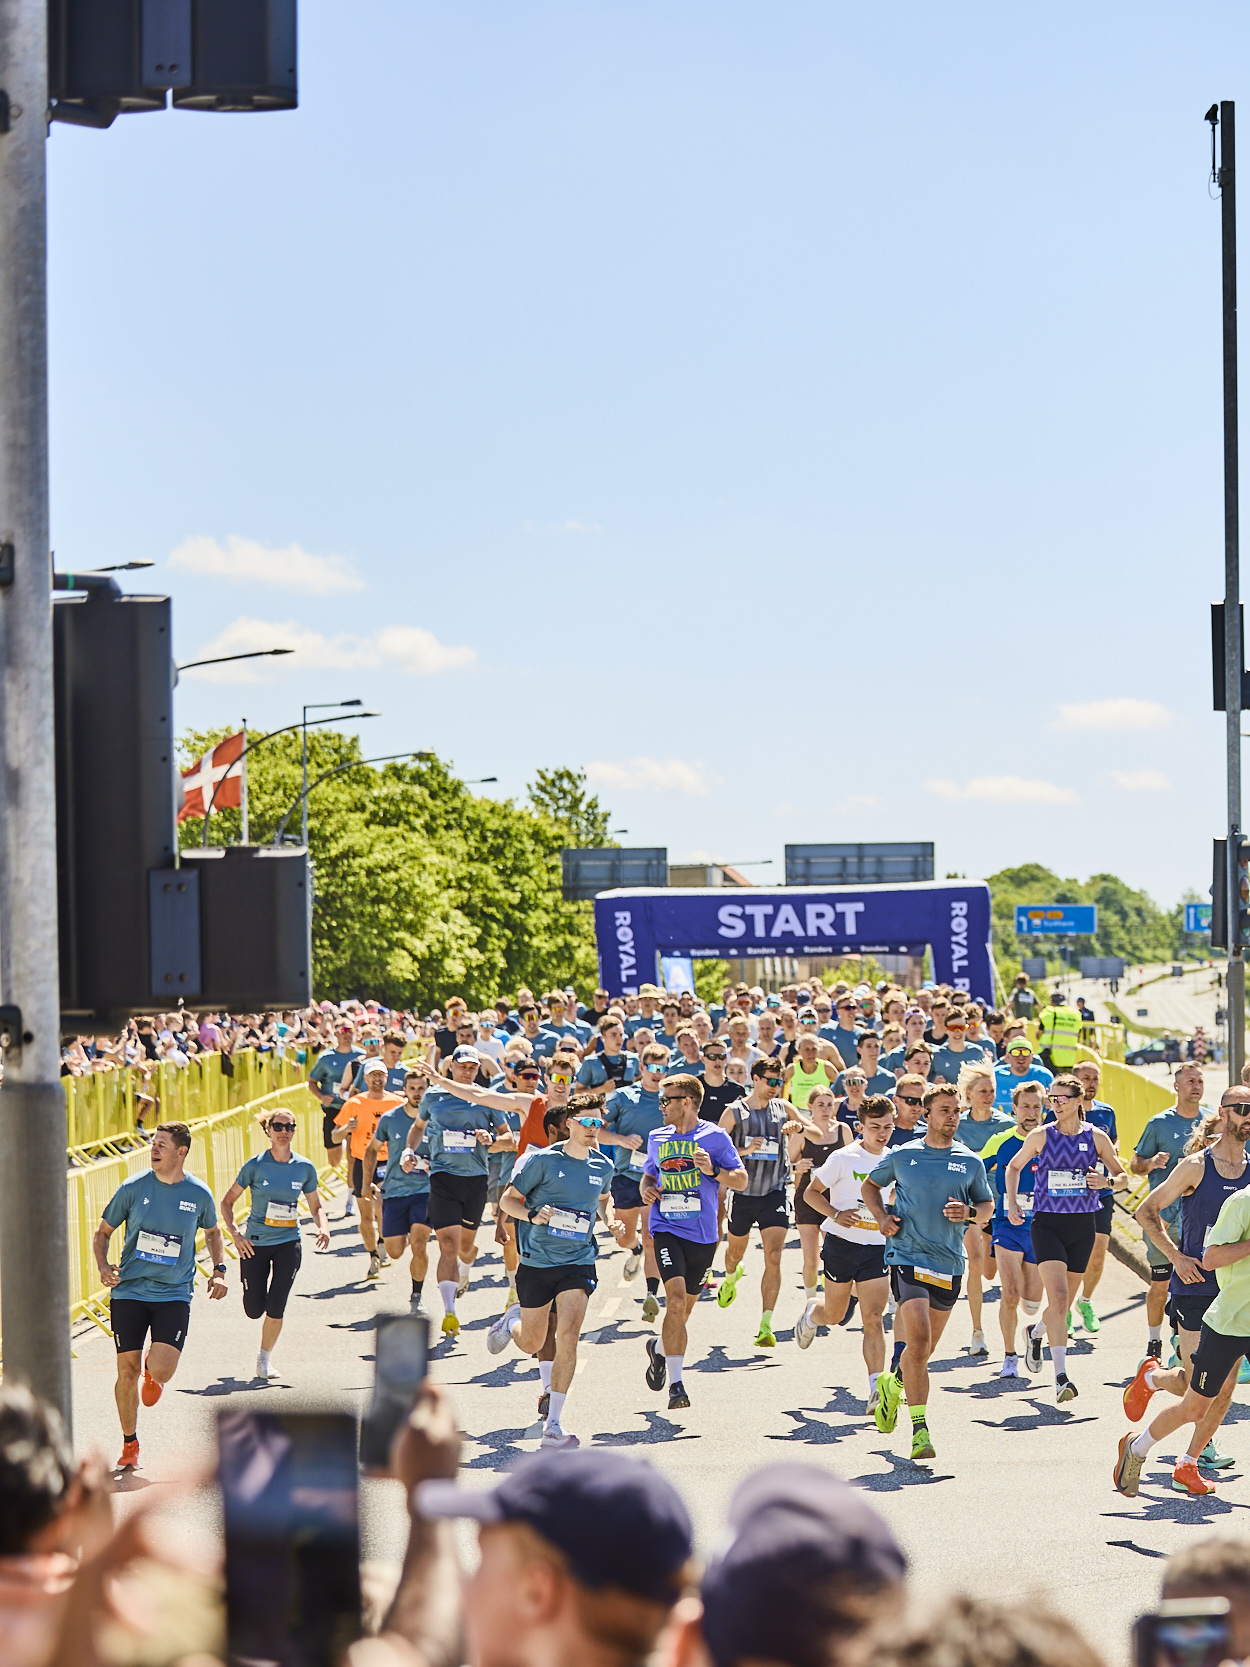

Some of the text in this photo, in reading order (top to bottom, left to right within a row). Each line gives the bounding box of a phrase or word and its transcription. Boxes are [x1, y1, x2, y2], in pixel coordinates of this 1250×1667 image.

[718, 902, 864, 938] START
[951, 901, 968, 974] ROYAL
[614, 910, 637, 983] ROYAL
[658, 1140, 699, 1160] MENTA
[948, 1162, 966, 1170] ROYAL
